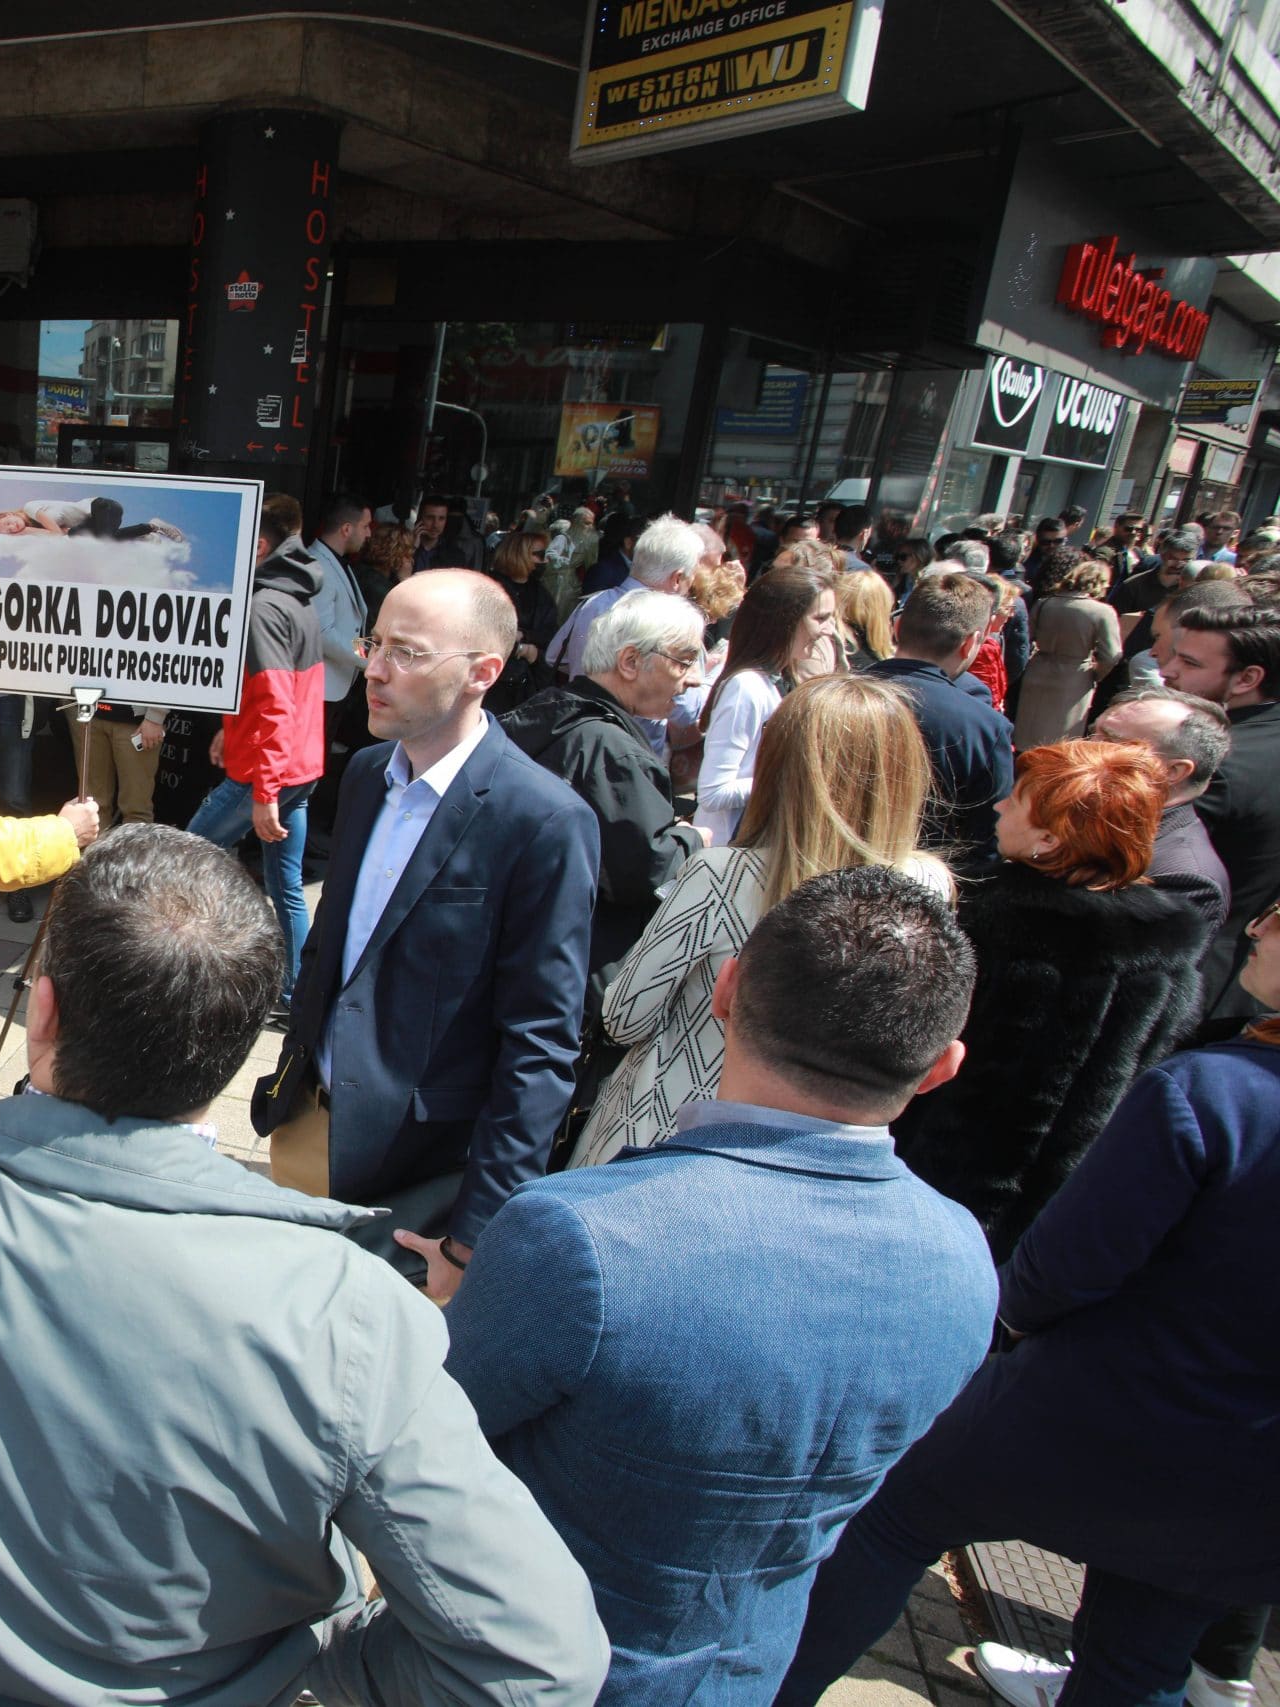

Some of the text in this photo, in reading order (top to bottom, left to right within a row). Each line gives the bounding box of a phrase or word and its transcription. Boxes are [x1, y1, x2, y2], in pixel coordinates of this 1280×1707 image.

[641, 1, 786, 52] EXCHANGE OFFICE
[607, 61, 720, 104] WESTERN
[735, 38, 811, 90] WU
[638, 80, 718, 113] UNION
[291, 159, 331, 429] HOSTEL
[999, 360, 1033, 399] Oculus
[95, 589, 232, 648] DOLOVAC
[57, 644, 112, 677] PUBLIC
[117, 650, 224, 688] PROSECUTOR
